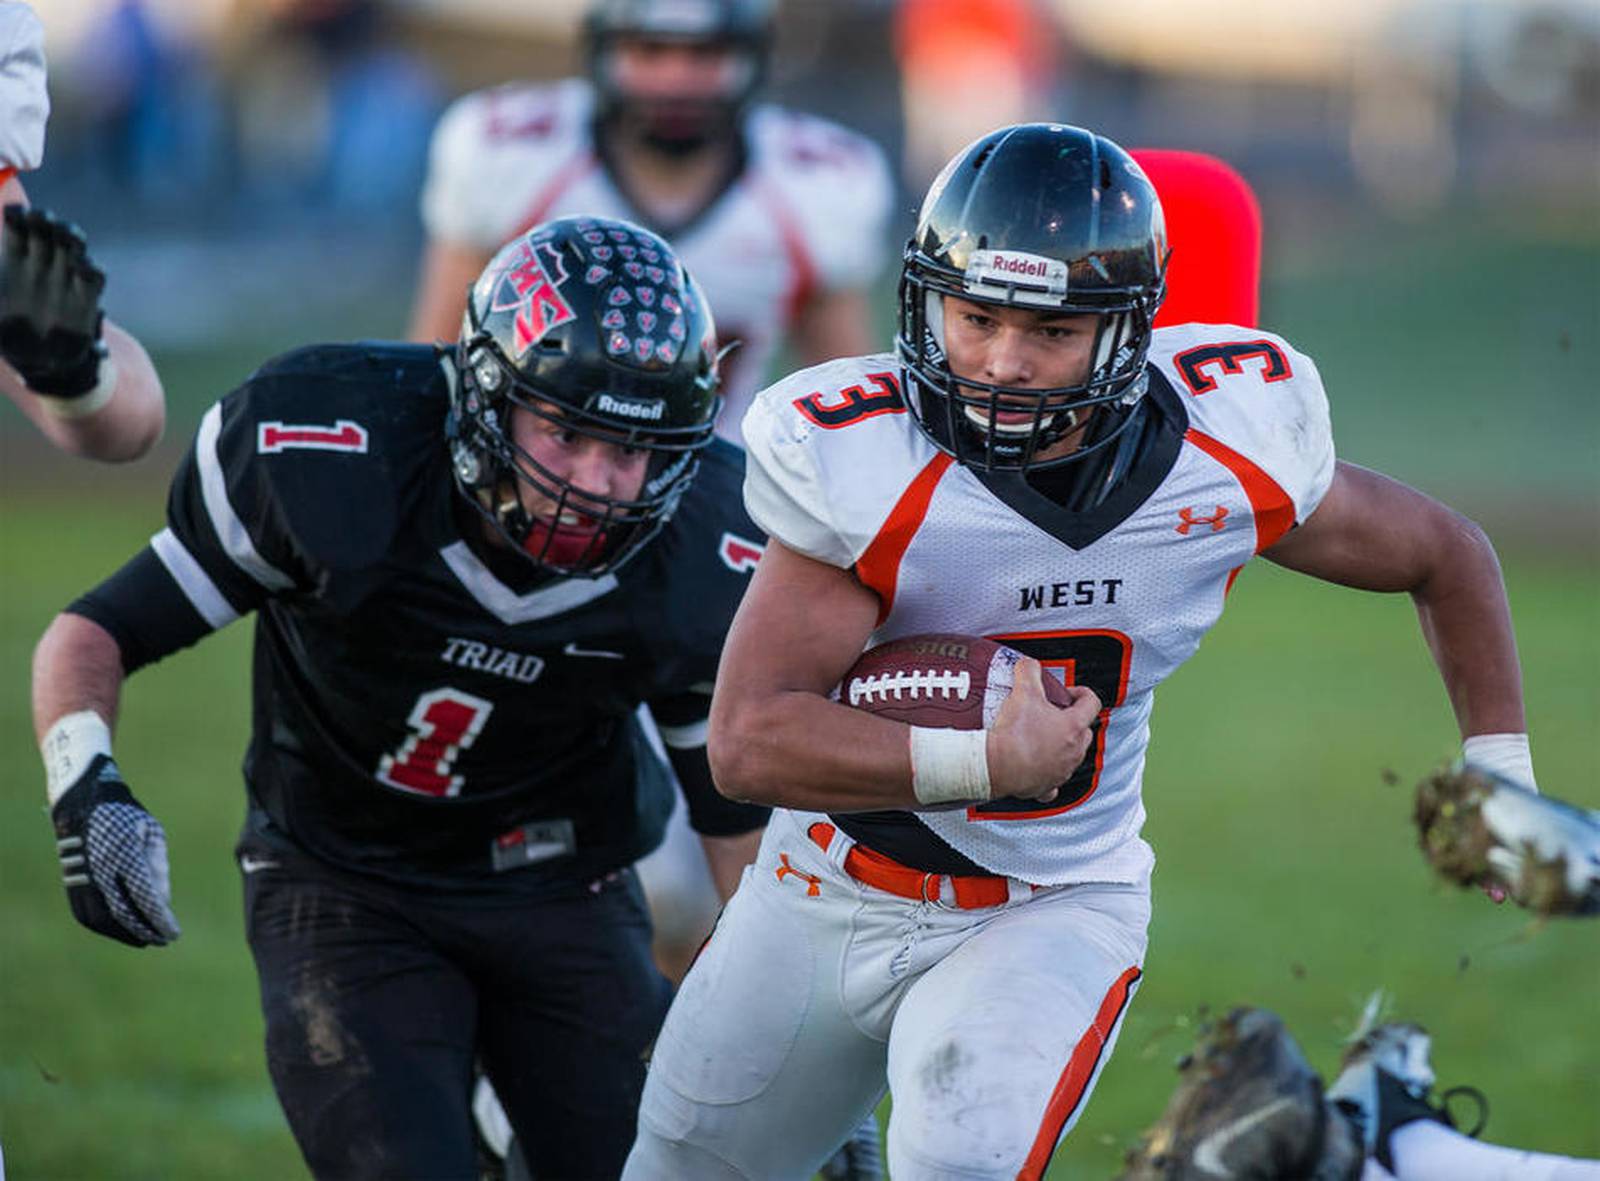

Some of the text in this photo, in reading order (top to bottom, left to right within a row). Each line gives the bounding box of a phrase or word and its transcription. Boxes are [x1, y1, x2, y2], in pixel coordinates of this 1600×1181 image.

[992, 255, 1048, 278] Riddell
[1172, 339, 1293, 397] 3
[598, 393, 664, 421] Riddell
[792, 371, 908, 430] 3
[257, 420, 369, 454] 1
[1018, 579, 1123, 612] WEST
[440, 636, 546, 684] TRIAD
[375, 686, 495, 798] 1
